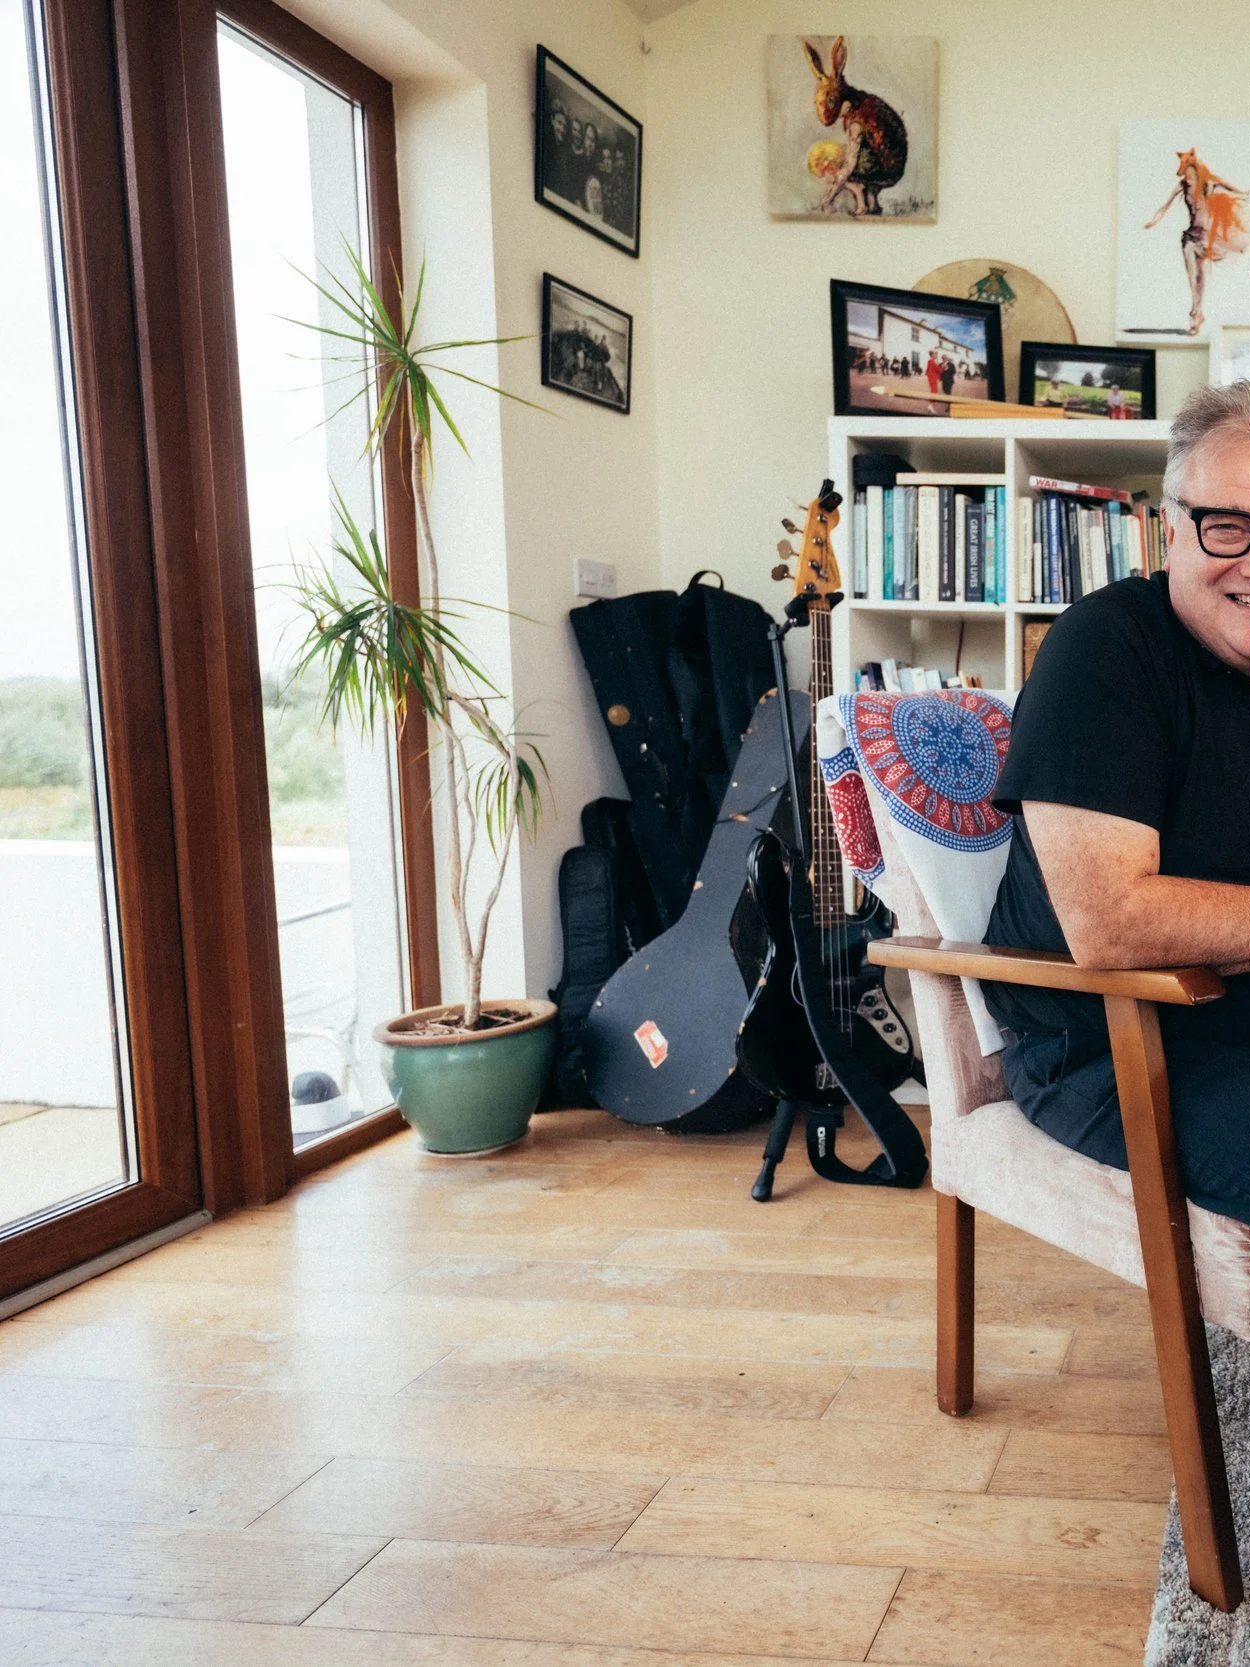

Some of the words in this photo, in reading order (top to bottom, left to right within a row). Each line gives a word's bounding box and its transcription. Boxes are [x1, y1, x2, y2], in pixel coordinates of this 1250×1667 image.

[1036, 479, 1058, 489] WAR
[970, 518, 979, 545] GREAT
[970, 545, 979, 566] IRISH
[970, 567, 979, 588] LIVES
